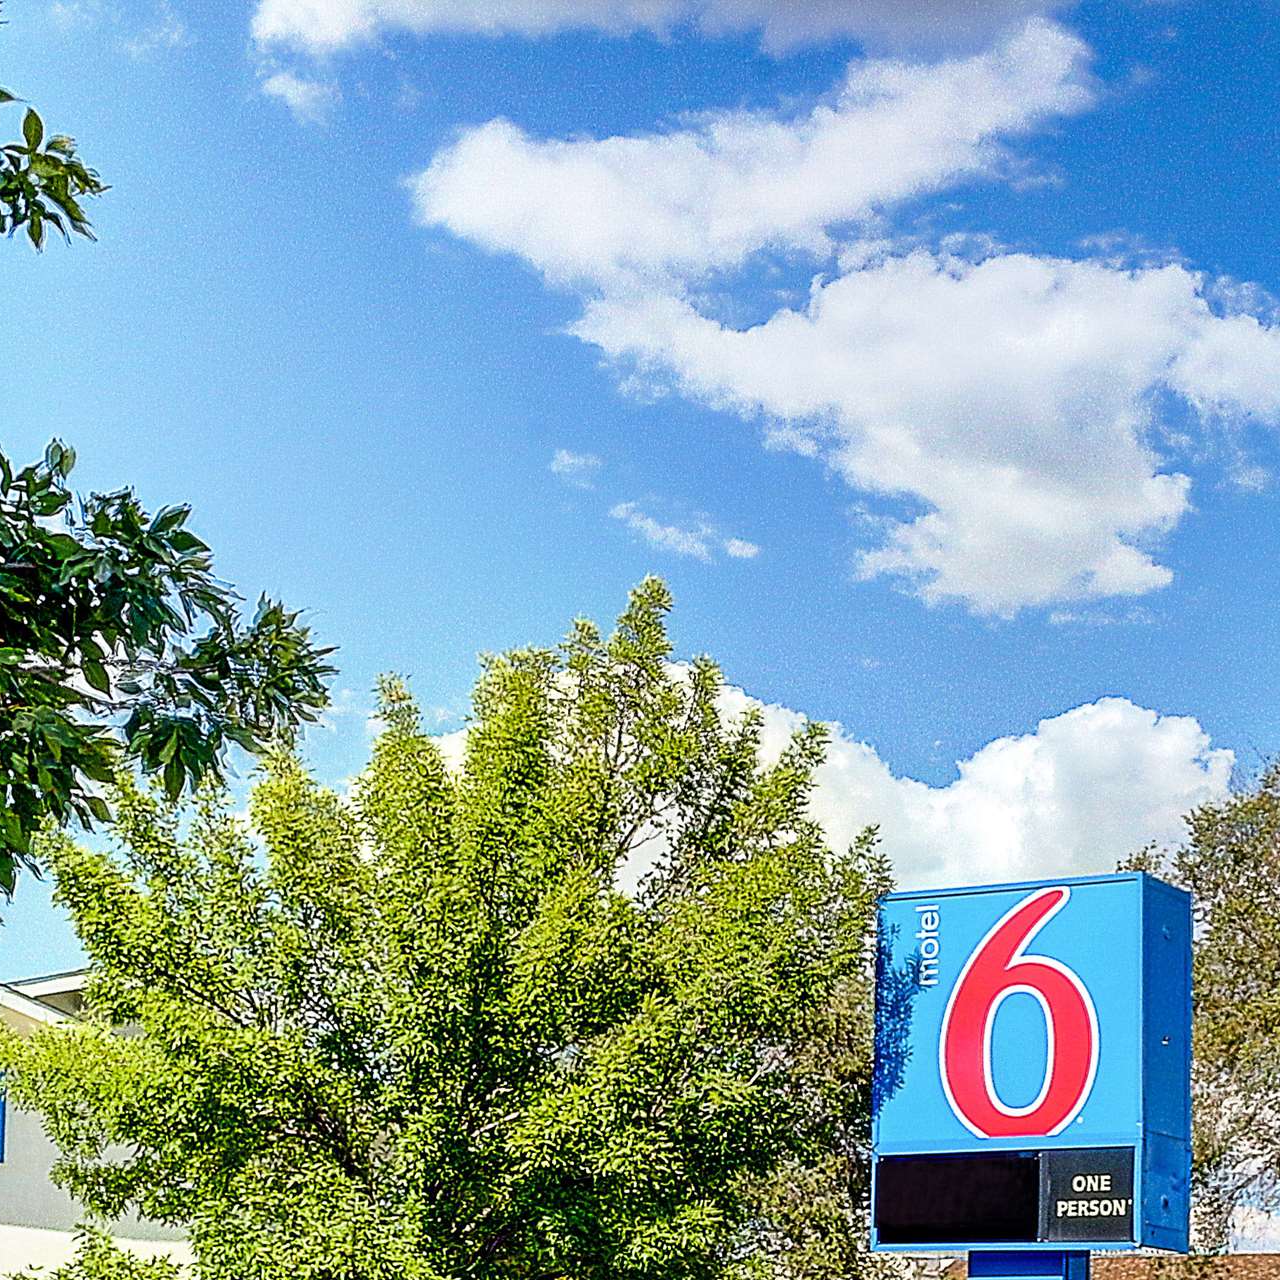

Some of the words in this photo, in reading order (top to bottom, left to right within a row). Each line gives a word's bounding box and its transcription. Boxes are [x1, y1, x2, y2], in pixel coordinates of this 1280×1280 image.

[915, 904, 940, 986] motel
[939, 886, 1101, 1139] 6
[1072, 1175, 1112, 1192] ONE
